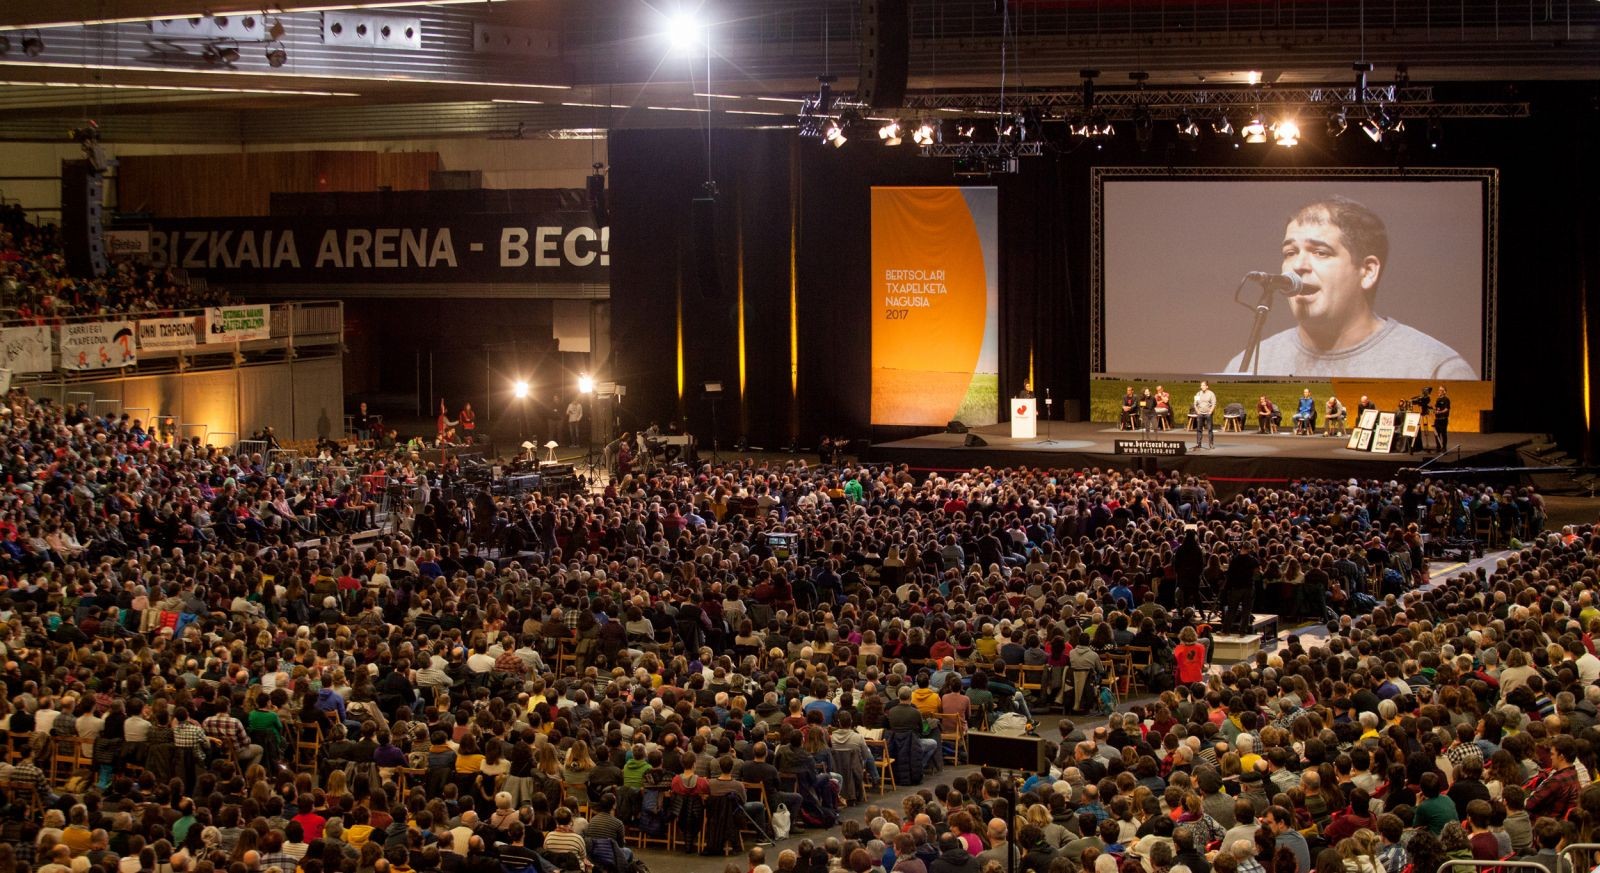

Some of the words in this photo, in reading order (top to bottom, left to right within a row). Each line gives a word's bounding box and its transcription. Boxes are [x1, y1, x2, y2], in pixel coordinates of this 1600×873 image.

[149, 229, 302, 268] BIZKAIA
[315, 228, 458, 267] ARENA
[470, 243, 484, 251] -
[500, 226, 610, 267] BEC!
[885, 269, 945, 280] BERTSOLARI
[886, 283, 947, 294] TXAPELKETA
[885, 296, 930, 307] NAGUSIA
[885, 309, 909, 320] 2017
[140, 323, 156, 337] UNAI
[160, 322, 194, 336] TXAPELDUN
